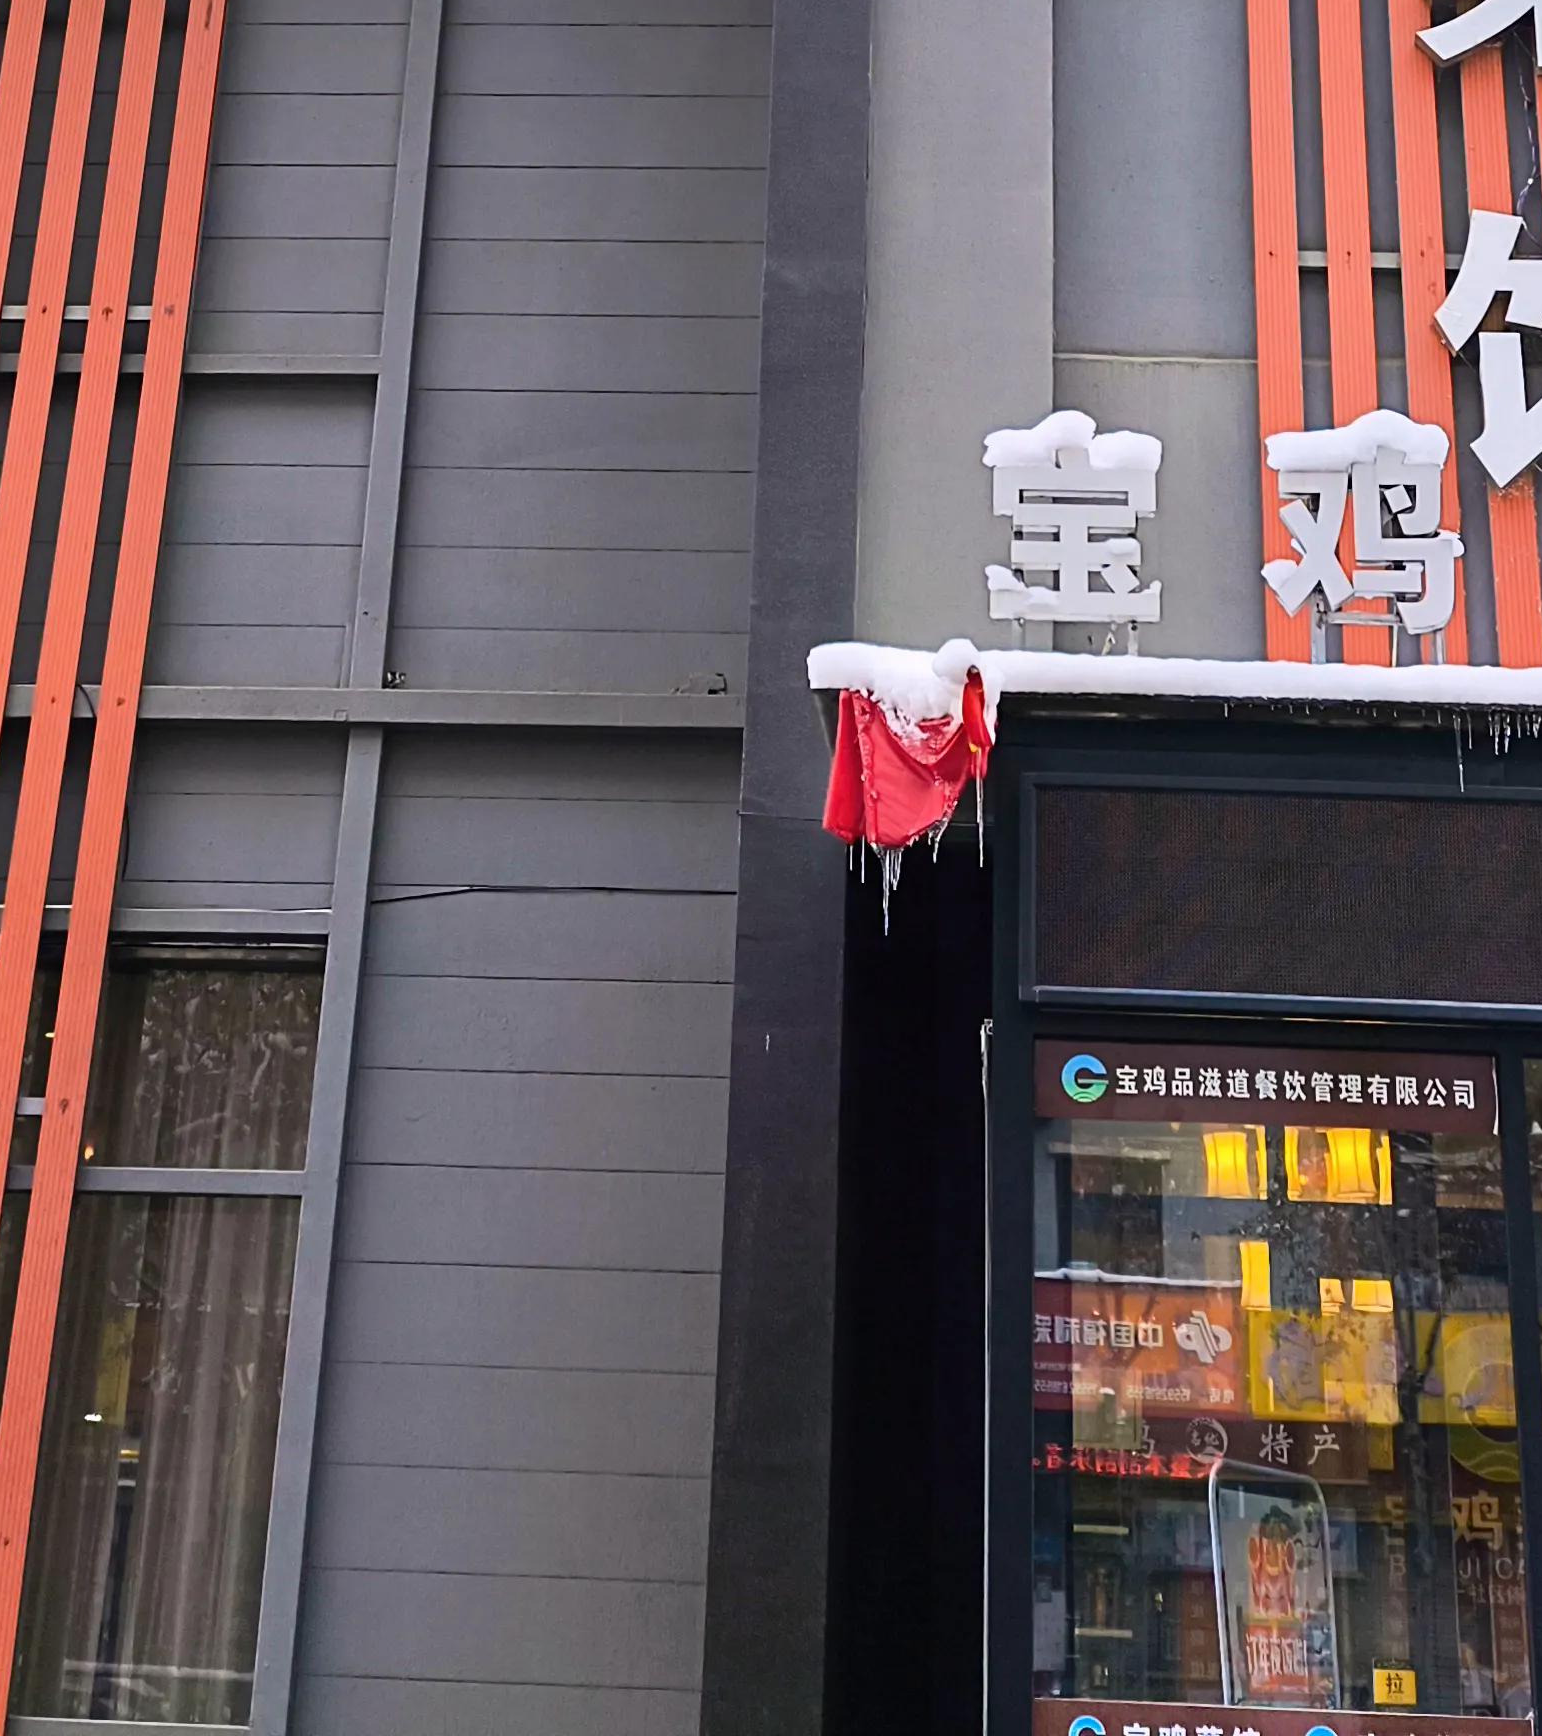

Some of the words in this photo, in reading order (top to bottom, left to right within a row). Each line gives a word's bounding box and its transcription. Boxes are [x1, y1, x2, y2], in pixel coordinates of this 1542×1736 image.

[1115, 1065, 1477, 1111] 宝鸡品滋道餐饮管理有限公司
[1386, 1672, 1405, 1695] 拉
